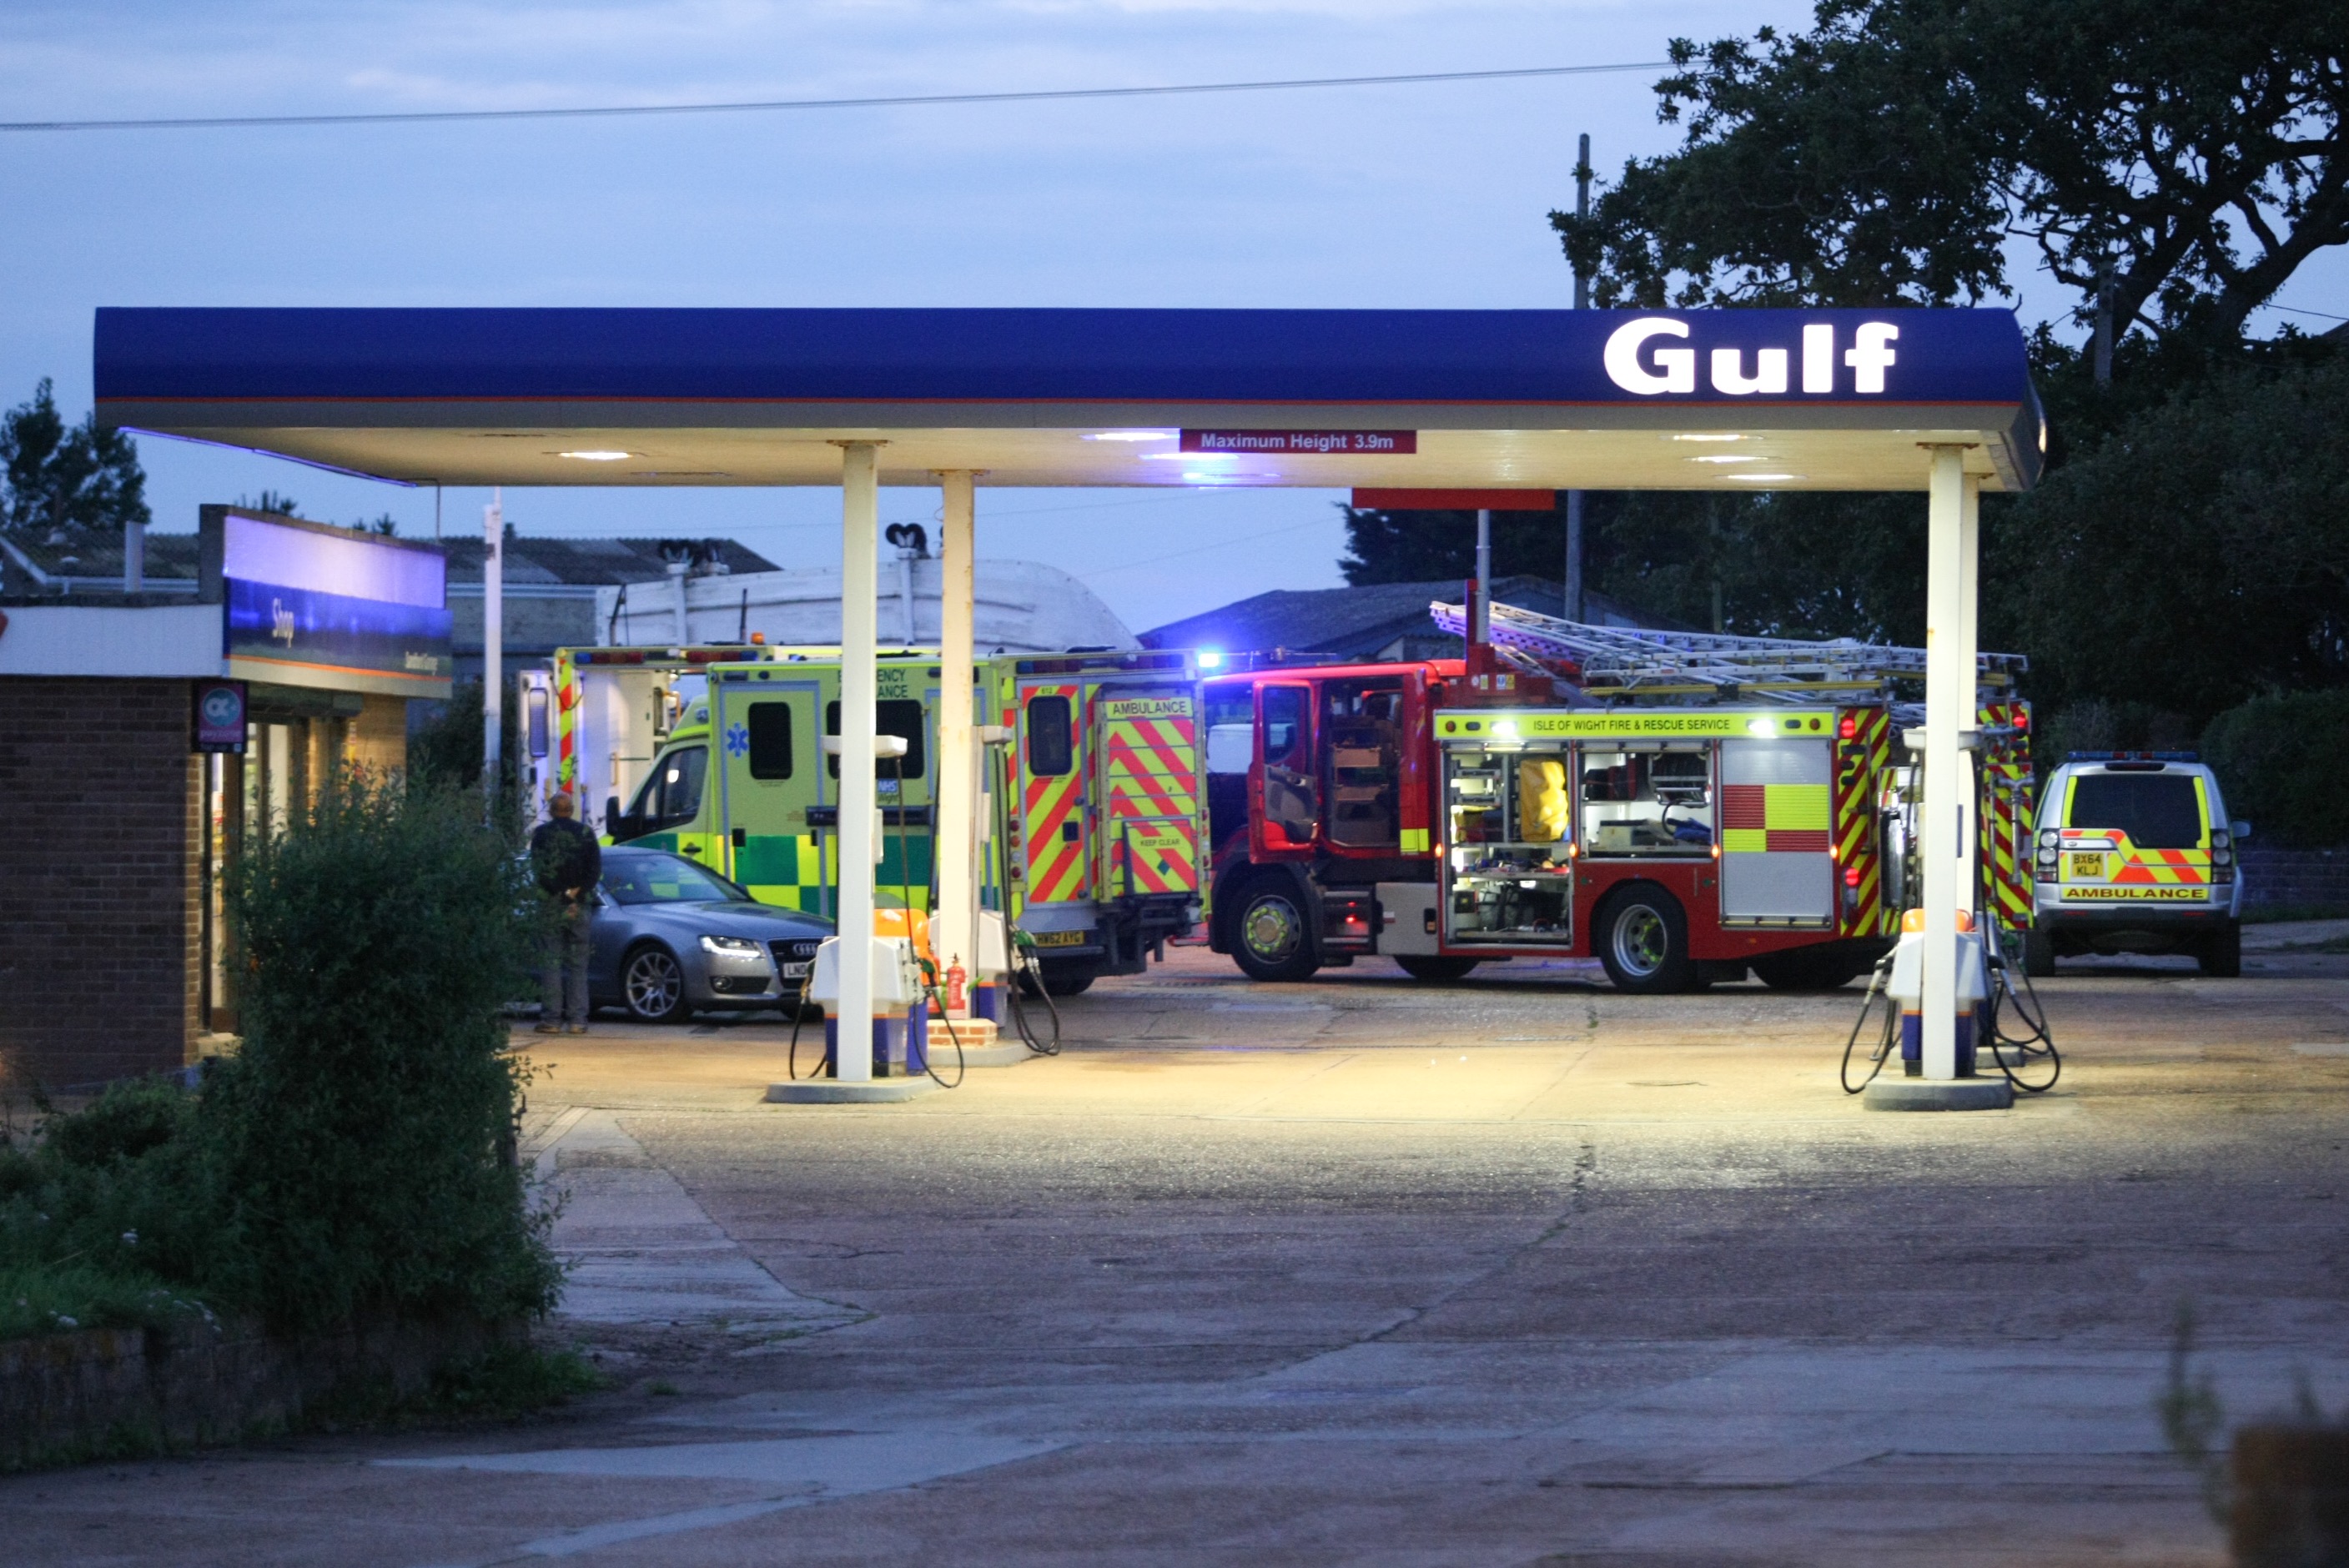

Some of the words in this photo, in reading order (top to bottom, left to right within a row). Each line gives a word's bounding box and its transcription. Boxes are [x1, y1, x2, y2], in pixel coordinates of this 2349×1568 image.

[1603, 317, 1899, 395] Gulf
[1201, 433, 1285, 448] Maximum
[1290, 434, 1347, 451] Height
[1355, 434, 1394, 449] 3.9m
[272, 597, 294, 648] Shop
[1113, 701, 1187, 715] AMBULANCE
[1533, 720, 1555, 731] ISLE
[1557, 720, 1572, 731] OF
[1573, 720, 1607, 731] WIGHT
[1609, 720, 1632, 731] FIRE
[1634, 720, 1641, 731] &
[1643, 720, 1684, 731] RESCUE
[1687, 719, 1731, 730] SERVICE
[878, 780, 898, 792] NHS
[1140, 838, 1157, 847] KEEP
[1159, 837, 1180, 847] CLEAR
[2073, 853, 2102, 864] BX64
[2076, 867, 2099, 876] KLJ
[2066, 888, 2205, 898] AMBULANCE
